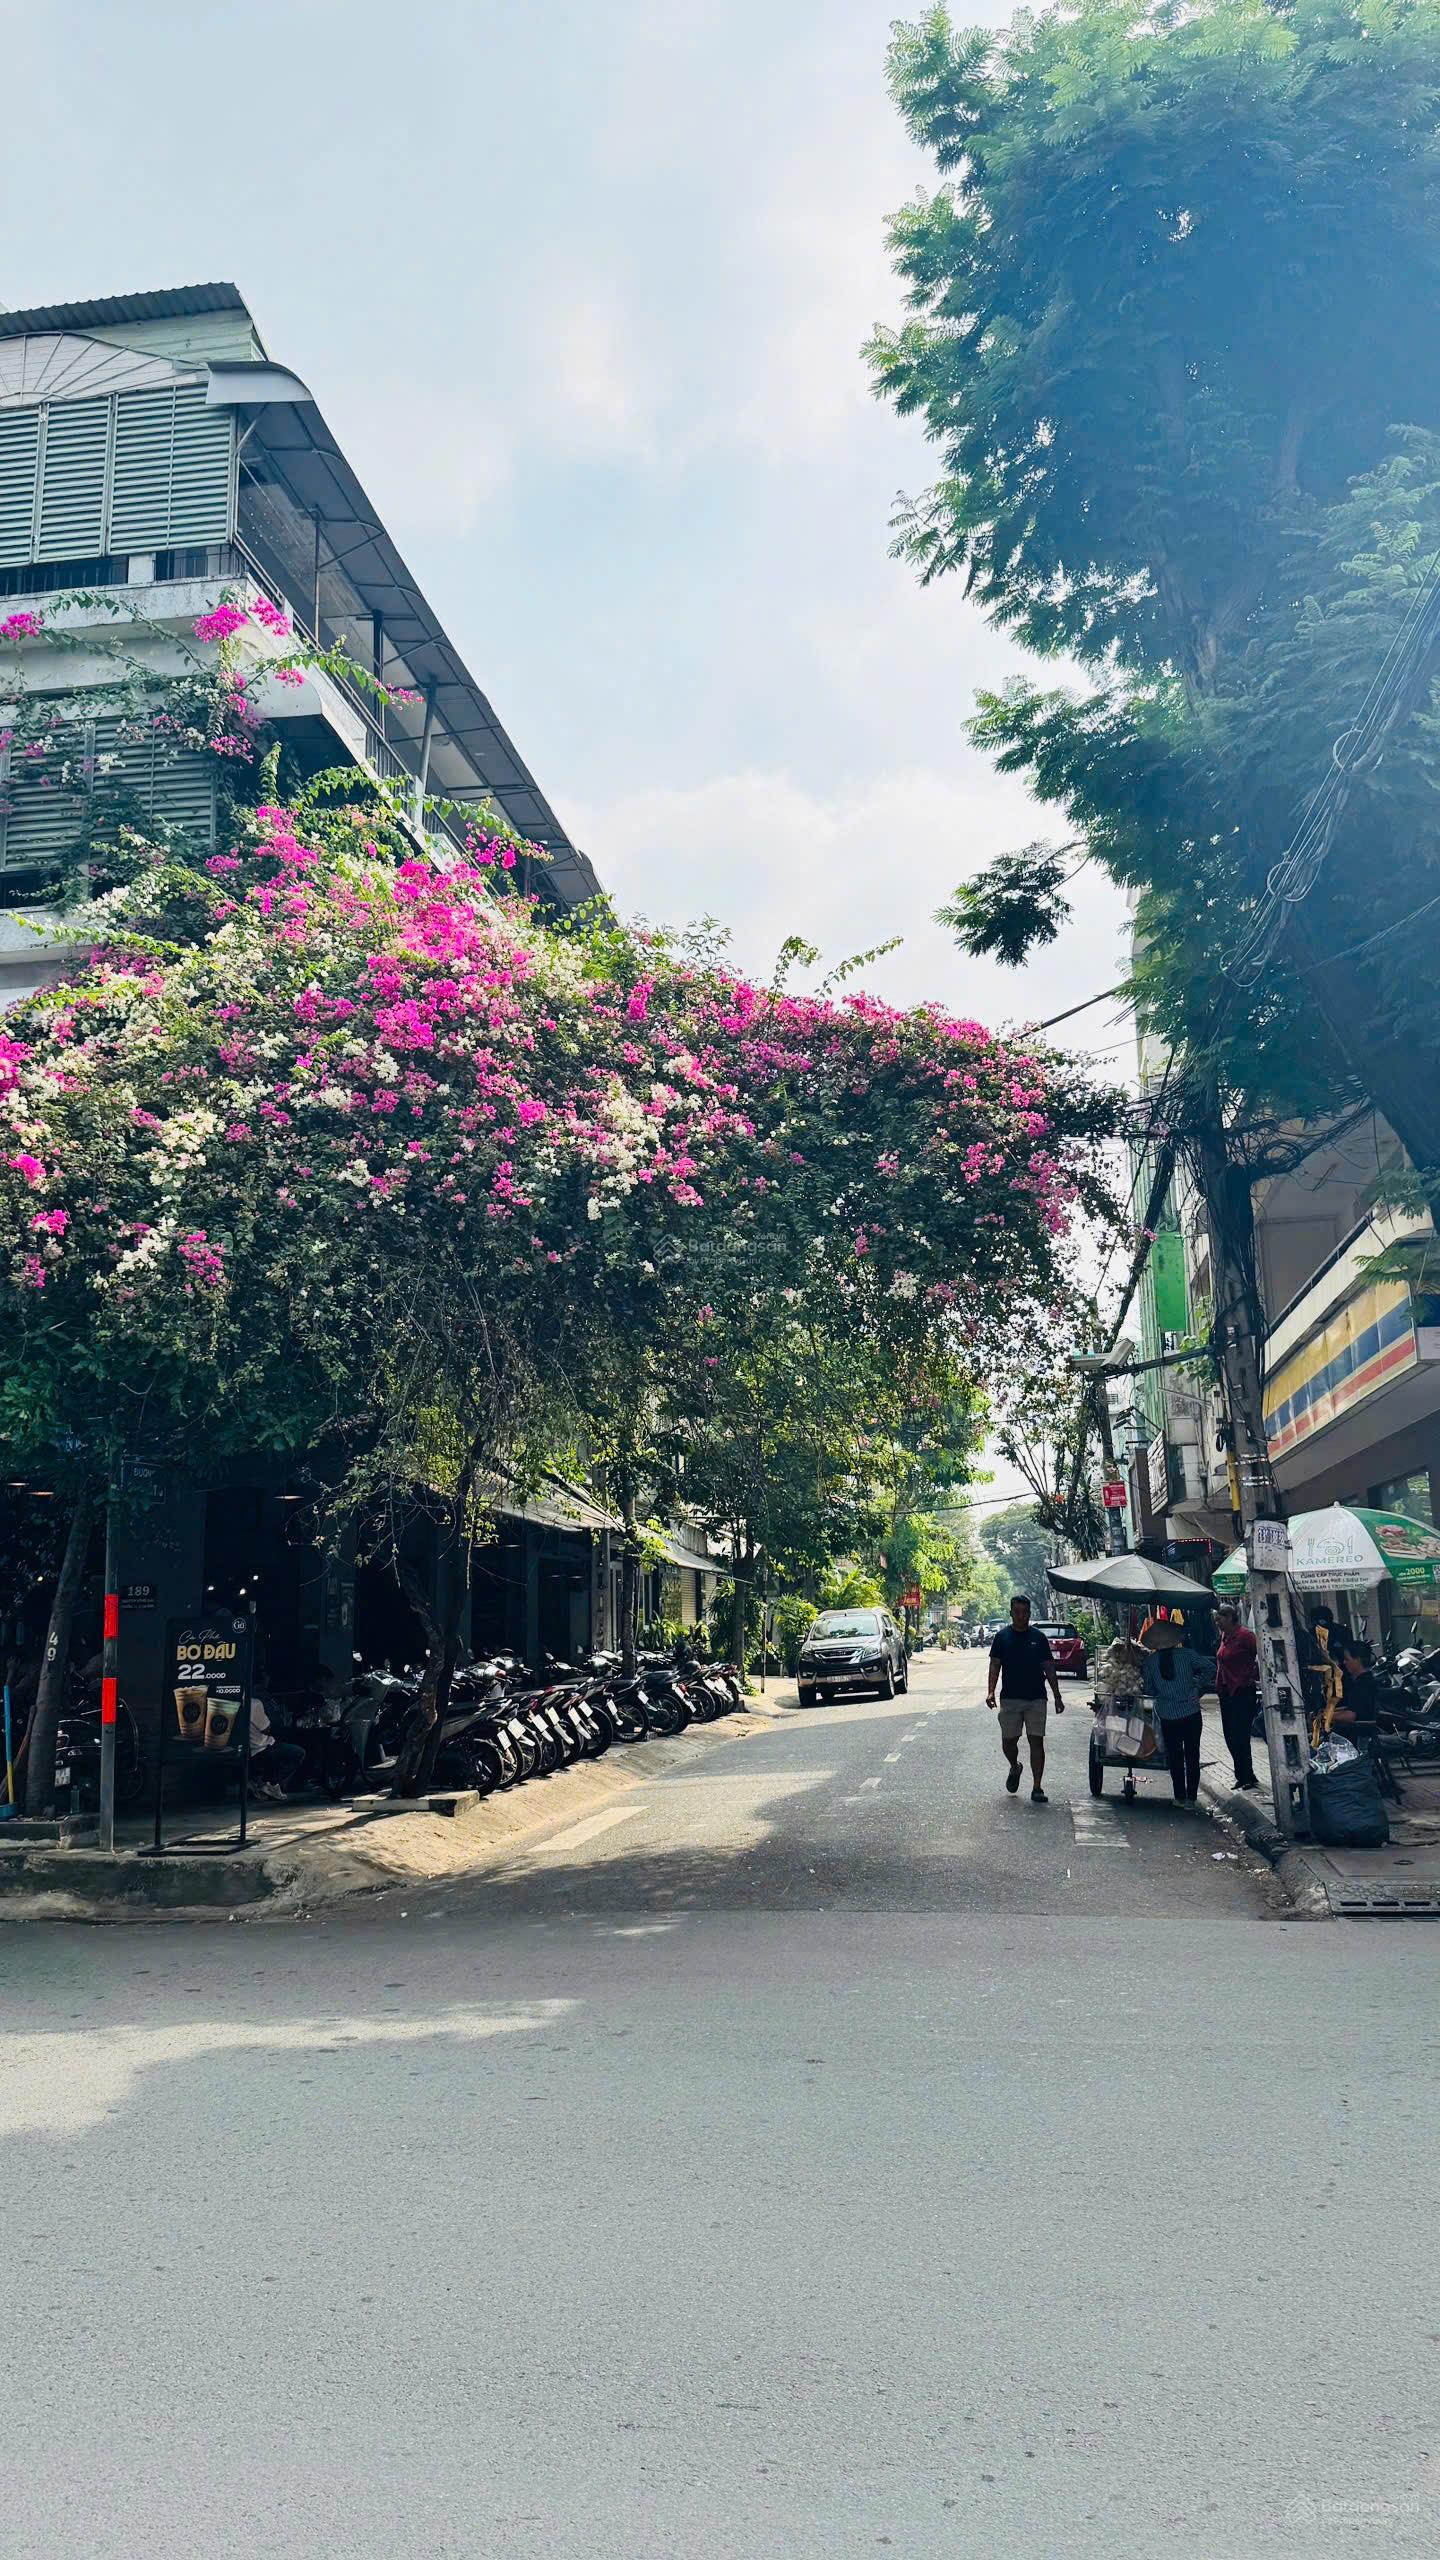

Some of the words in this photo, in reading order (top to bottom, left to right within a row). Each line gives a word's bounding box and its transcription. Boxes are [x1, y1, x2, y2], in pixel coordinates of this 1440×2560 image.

[1296, 1554, 1363, 1566] KAMEREO
[1405, 1567, 1425, 1575] 2000
[127, 1585, 150, 1596] 189
[203, 1640, 237, 1662] ĐẬU
